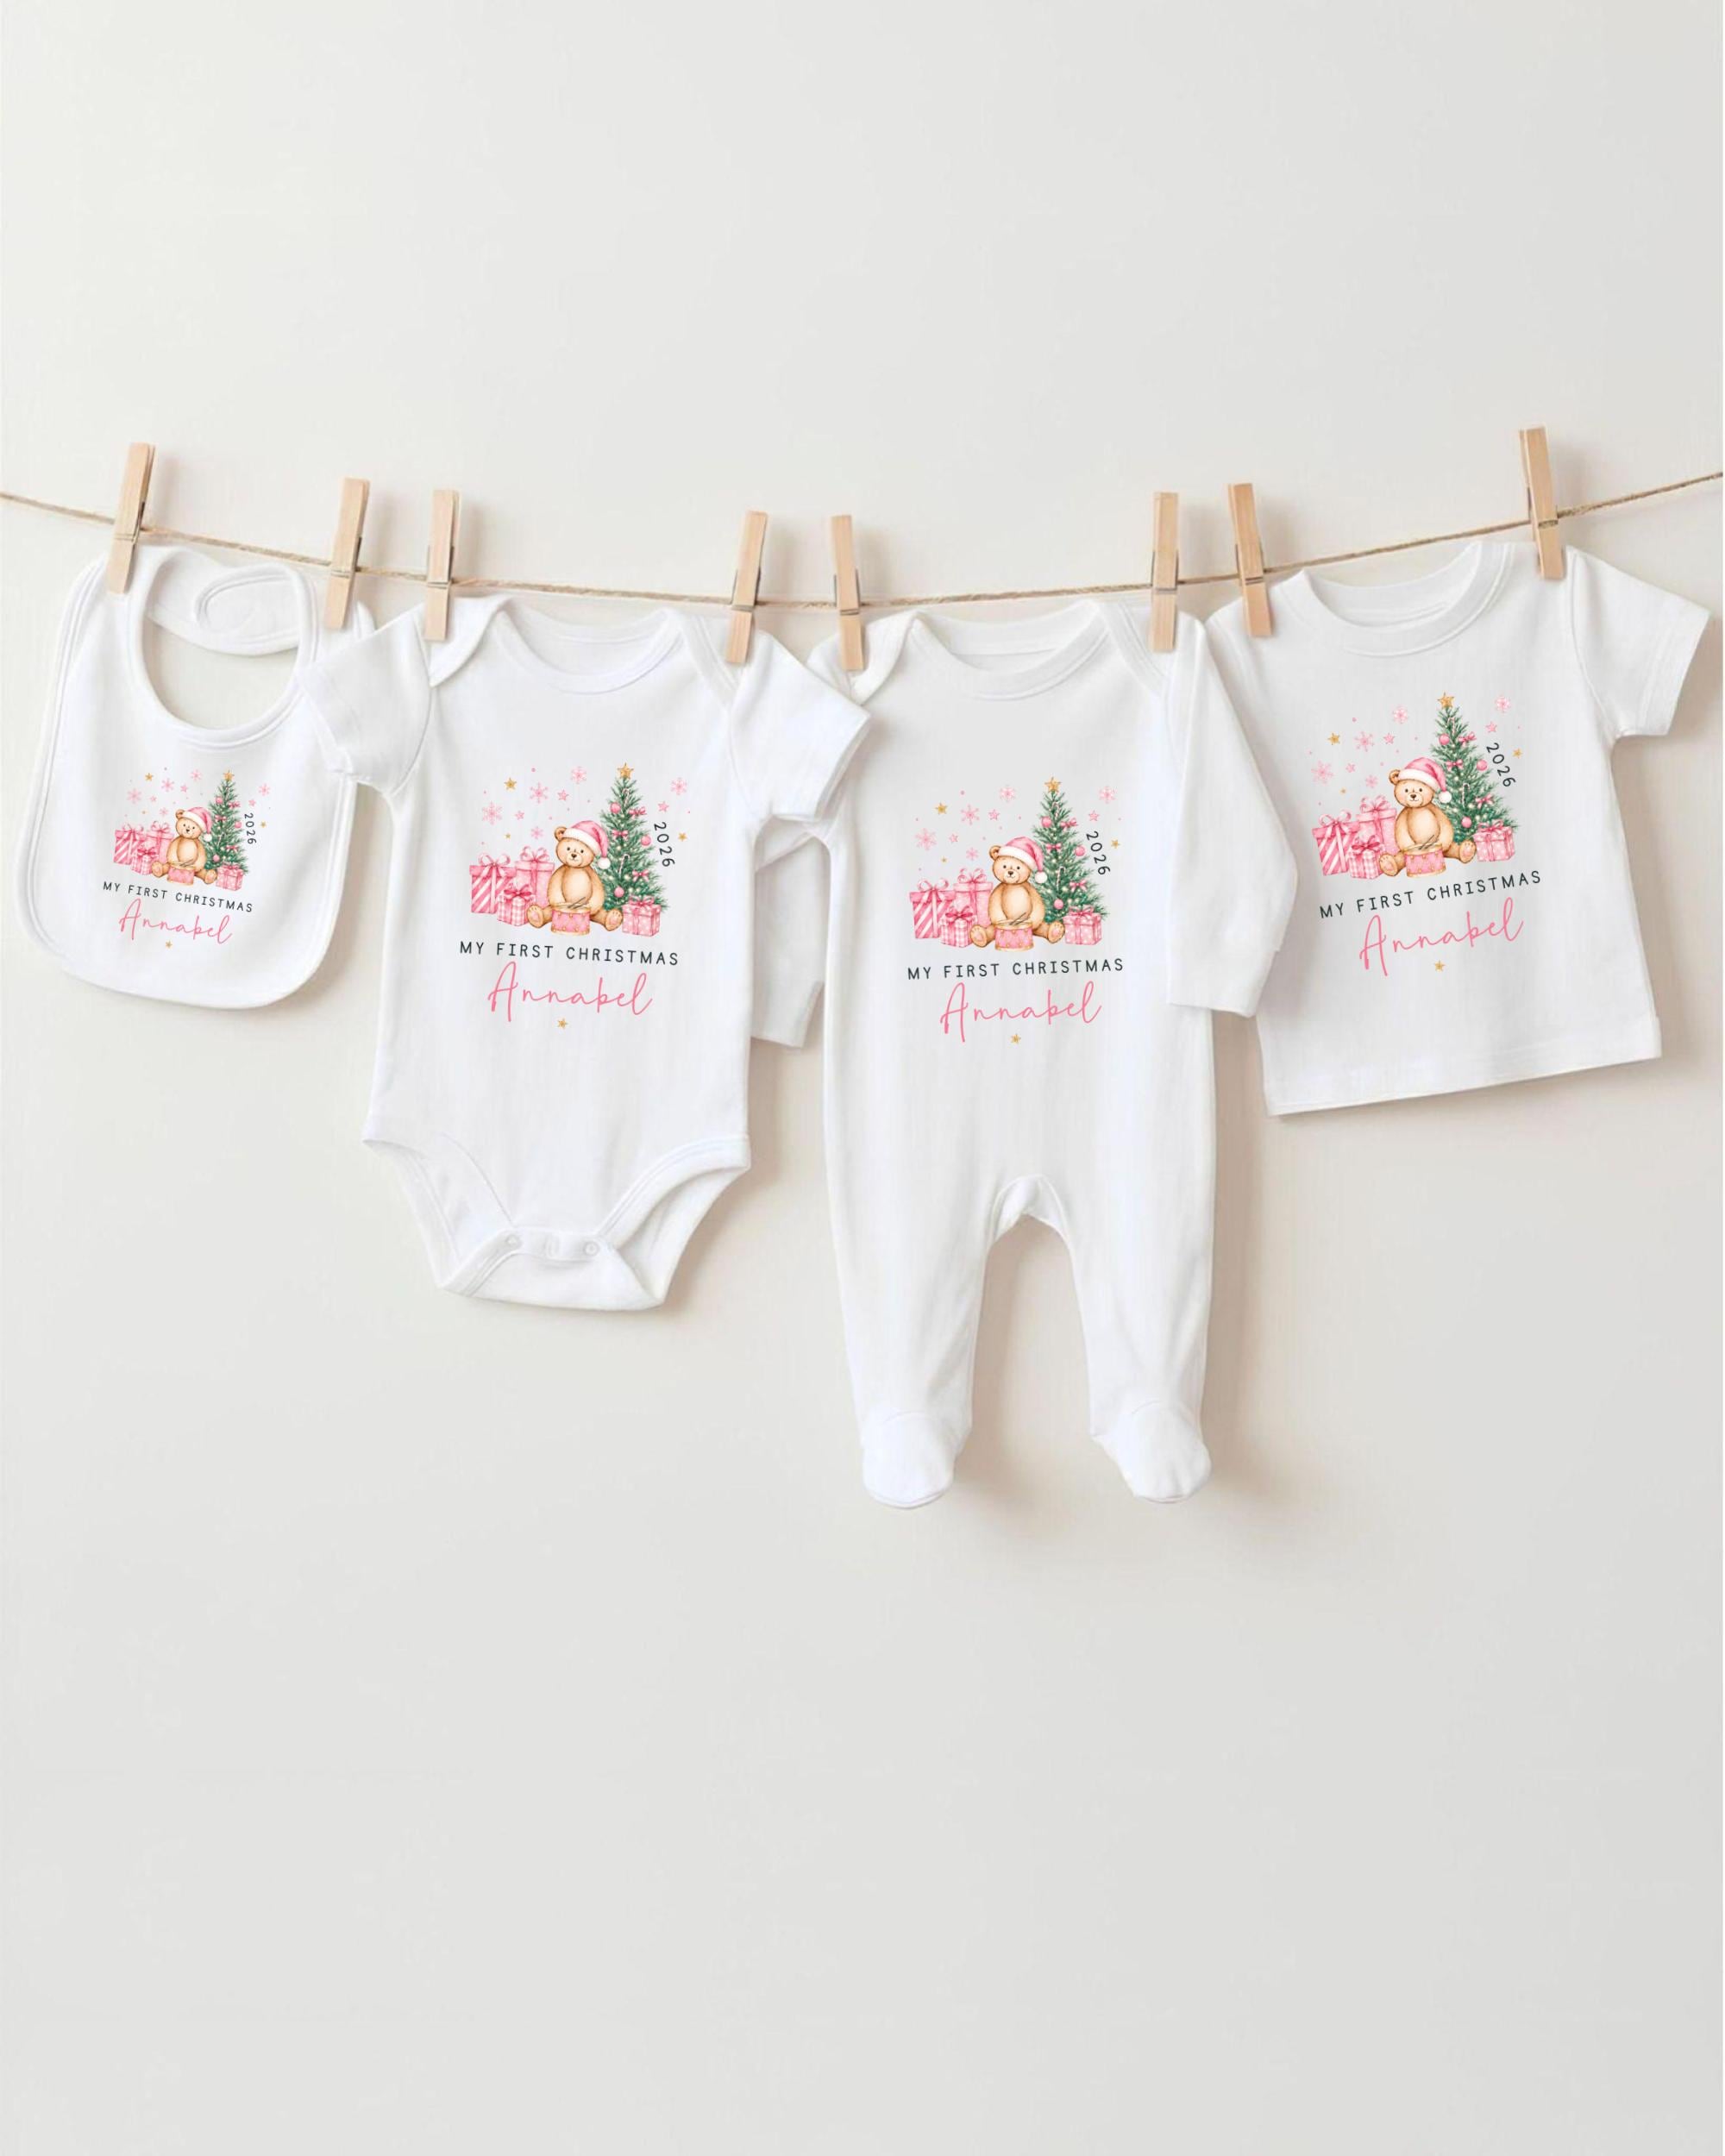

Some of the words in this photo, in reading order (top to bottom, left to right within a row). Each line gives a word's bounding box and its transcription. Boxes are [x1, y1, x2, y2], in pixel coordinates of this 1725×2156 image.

[1486, 742, 1516, 788] 2026
[244, 812, 257, 845] 2026
[654, 821, 675, 868] 2026
[1086, 830, 1111, 876] 2026
[103, 881, 121, 893] MY
[128, 884, 168, 900] FIRST
[175, 892, 253, 913] CHRISTMAS
[1319, 902, 1344, 919] MY
[1356, 891, 1414, 914] FIRST
[1427, 870, 1541, 902] CHRISTMAS
[118, 898, 233, 944] Annabel
[1358, 897, 1524, 977] Annabel
[460, 941, 485, 955] MY
[496, 943, 554, 959] FIRST
[566, 946, 679, 966] CHRISTMAS
[907, 967, 932, 981] MY
[944, 963, 1000, 979] FIRST
[1012, 958, 1124, 975] CHRISTMAS
[487, 961, 653, 1022] Annabel
[939, 981, 1102, 1044] Annabel
